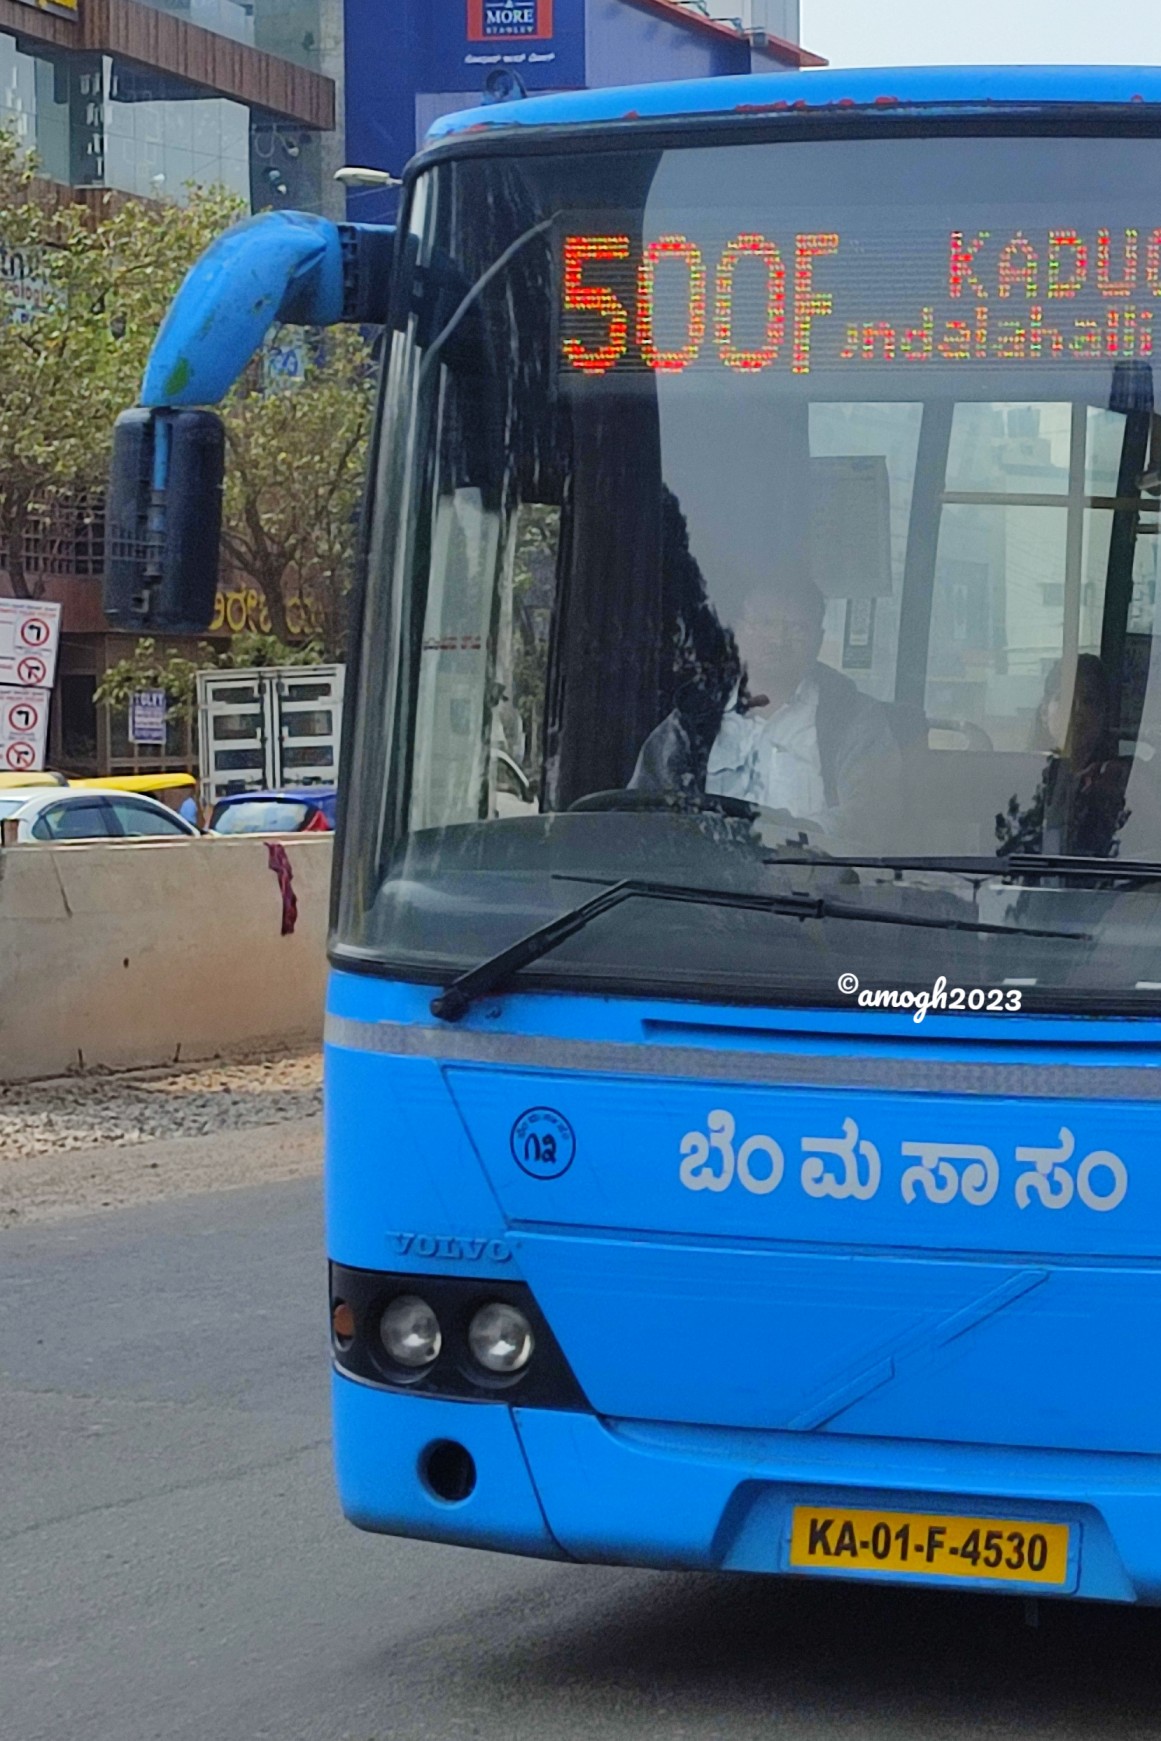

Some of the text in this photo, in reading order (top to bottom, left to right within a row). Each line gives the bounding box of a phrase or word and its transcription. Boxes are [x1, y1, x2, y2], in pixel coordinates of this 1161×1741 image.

[486, 9, 534, 24] MORE
[563, 233, 839, 376] 500F
[386, 1231, 515, 1263] VOLVO
[807, 1517, 1049, 1572] KA-01-F-4530
